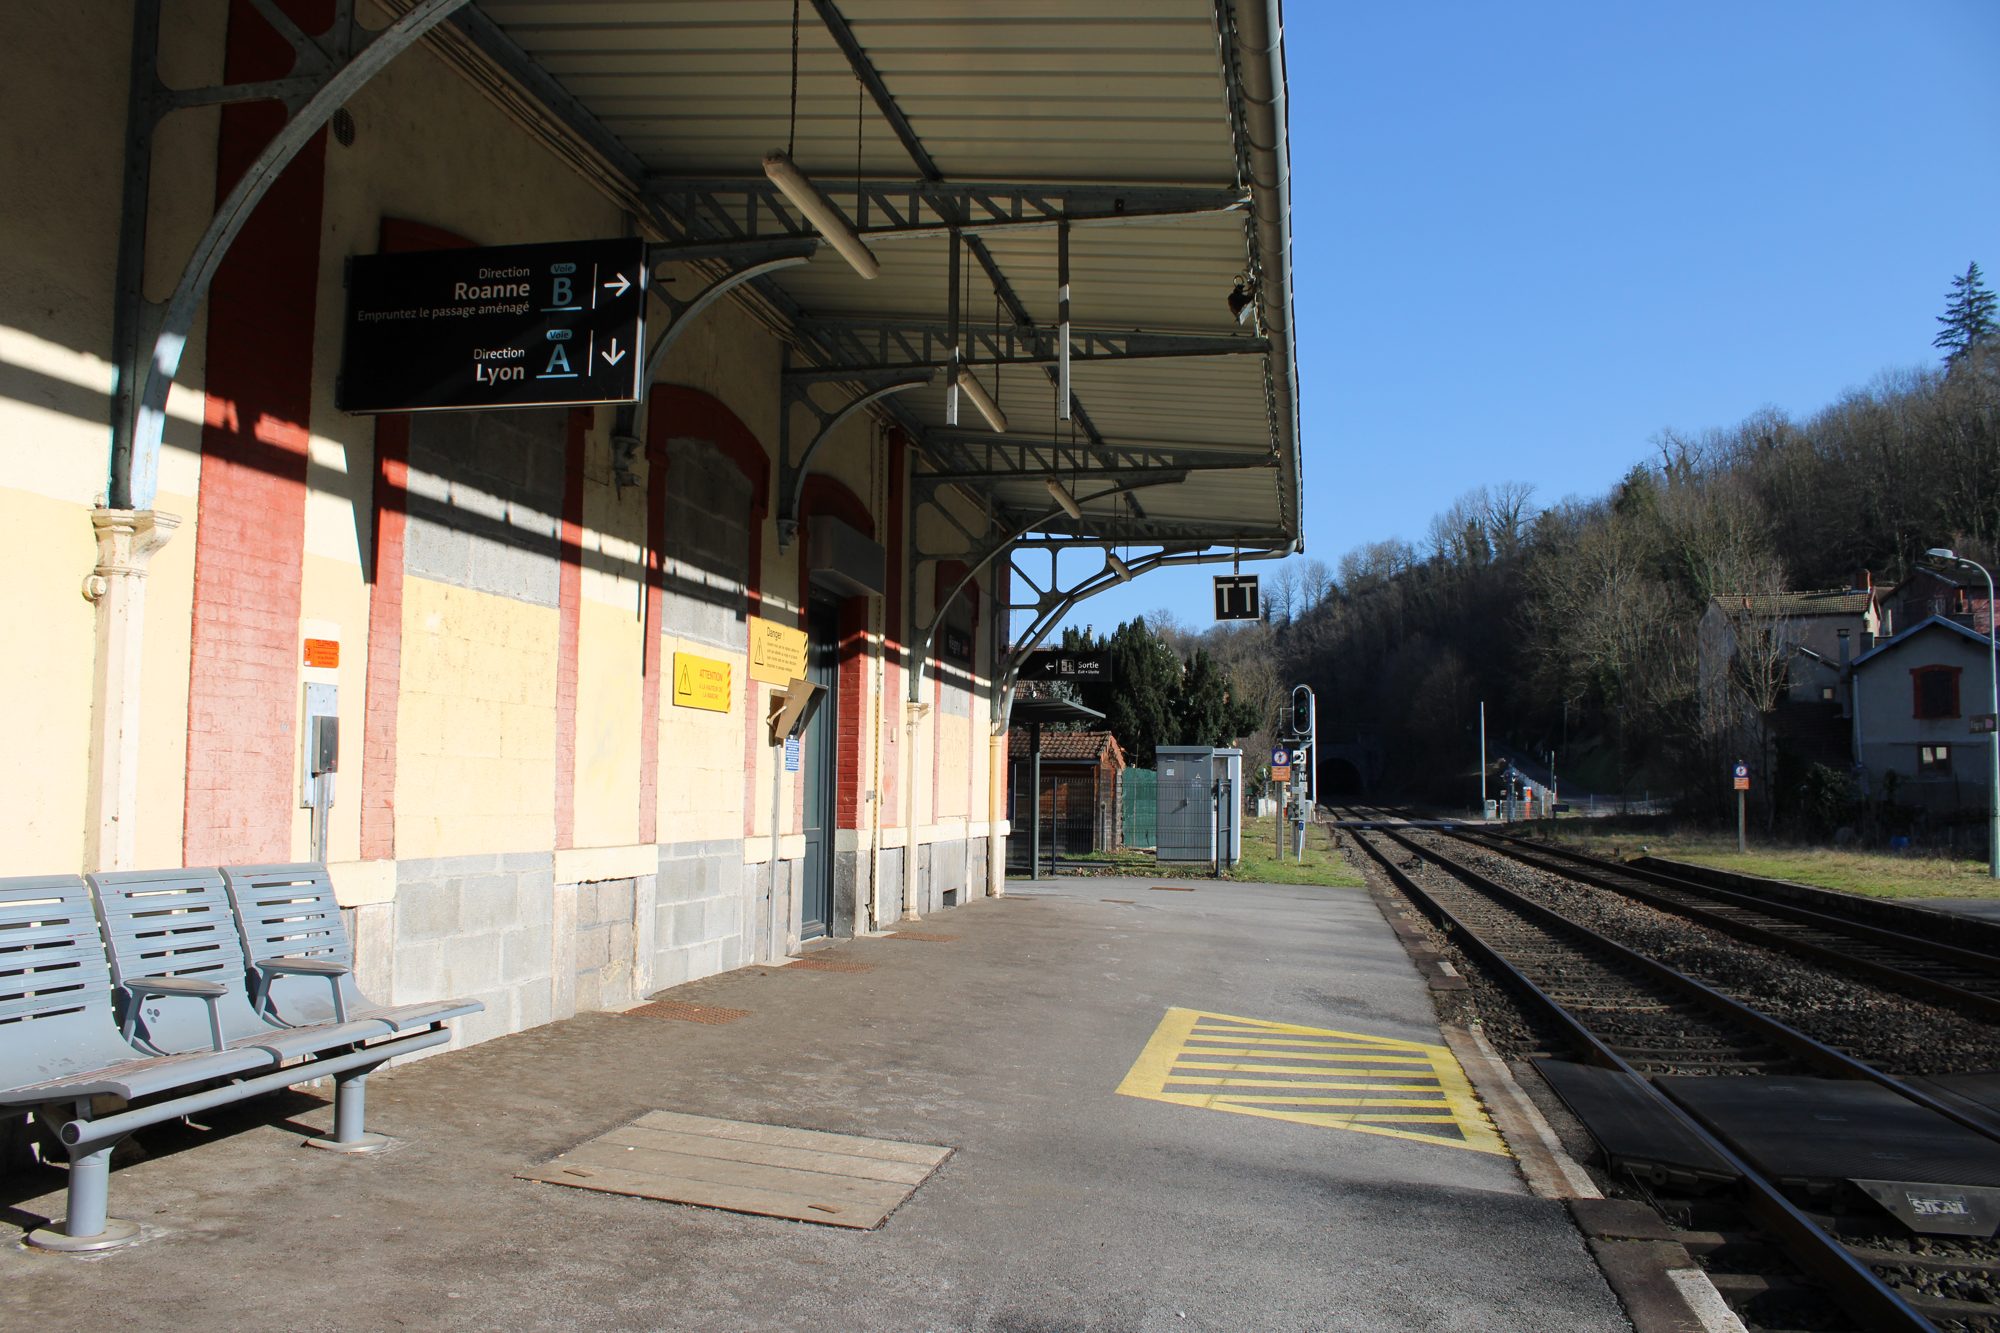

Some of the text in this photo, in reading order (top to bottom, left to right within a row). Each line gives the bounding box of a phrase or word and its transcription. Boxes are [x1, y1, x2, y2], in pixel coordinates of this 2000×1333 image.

[479, 266, 530, 280] Direction
[553, 264, 573, 273] Voie
[454, 282, 530, 301] Roanne
[552, 277, 573, 307] B
[357, 301, 530, 322] Empruntez le passage aménagé
[549, 331, 569, 339] Voie
[473, 347, 525, 360] Direction
[545, 343, 571, 373] A
[476, 363, 525, 386] Lyon
[1217, 583, 1256, 612] TT
[767, 626, 782, 641] Danger
[699, 669, 723, 682] ATTENTION
